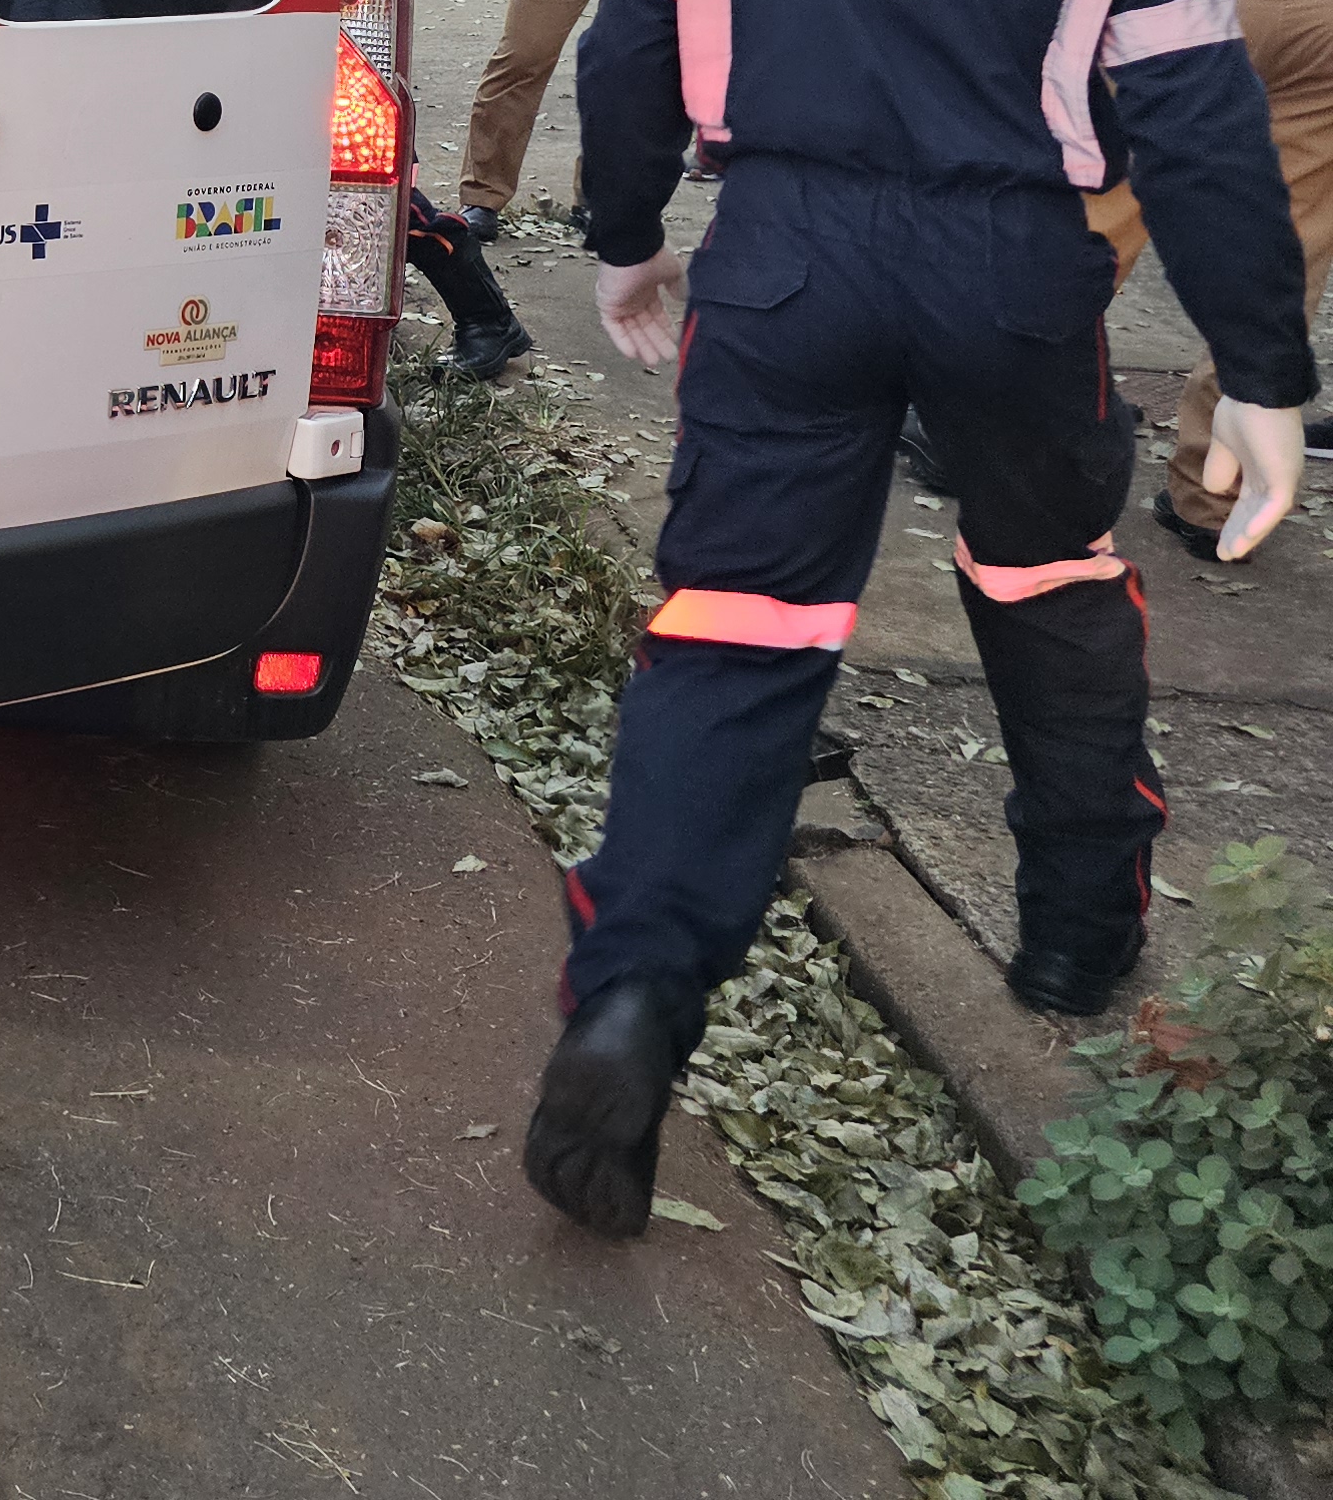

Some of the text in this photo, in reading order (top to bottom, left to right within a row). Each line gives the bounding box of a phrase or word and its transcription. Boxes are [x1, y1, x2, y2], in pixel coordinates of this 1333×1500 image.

[187, 182, 276, 197] GOVERNO FEDERAL
[175, 196, 282, 240] BRASIL
[183, 242, 206, 253] UNIÃO
[216, 236, 272, 250] RECONSTRUÇÃO
[146, 324, 238, 348] NOVA ALIANÇA
[107, 369, 277, 419] RENAULT
